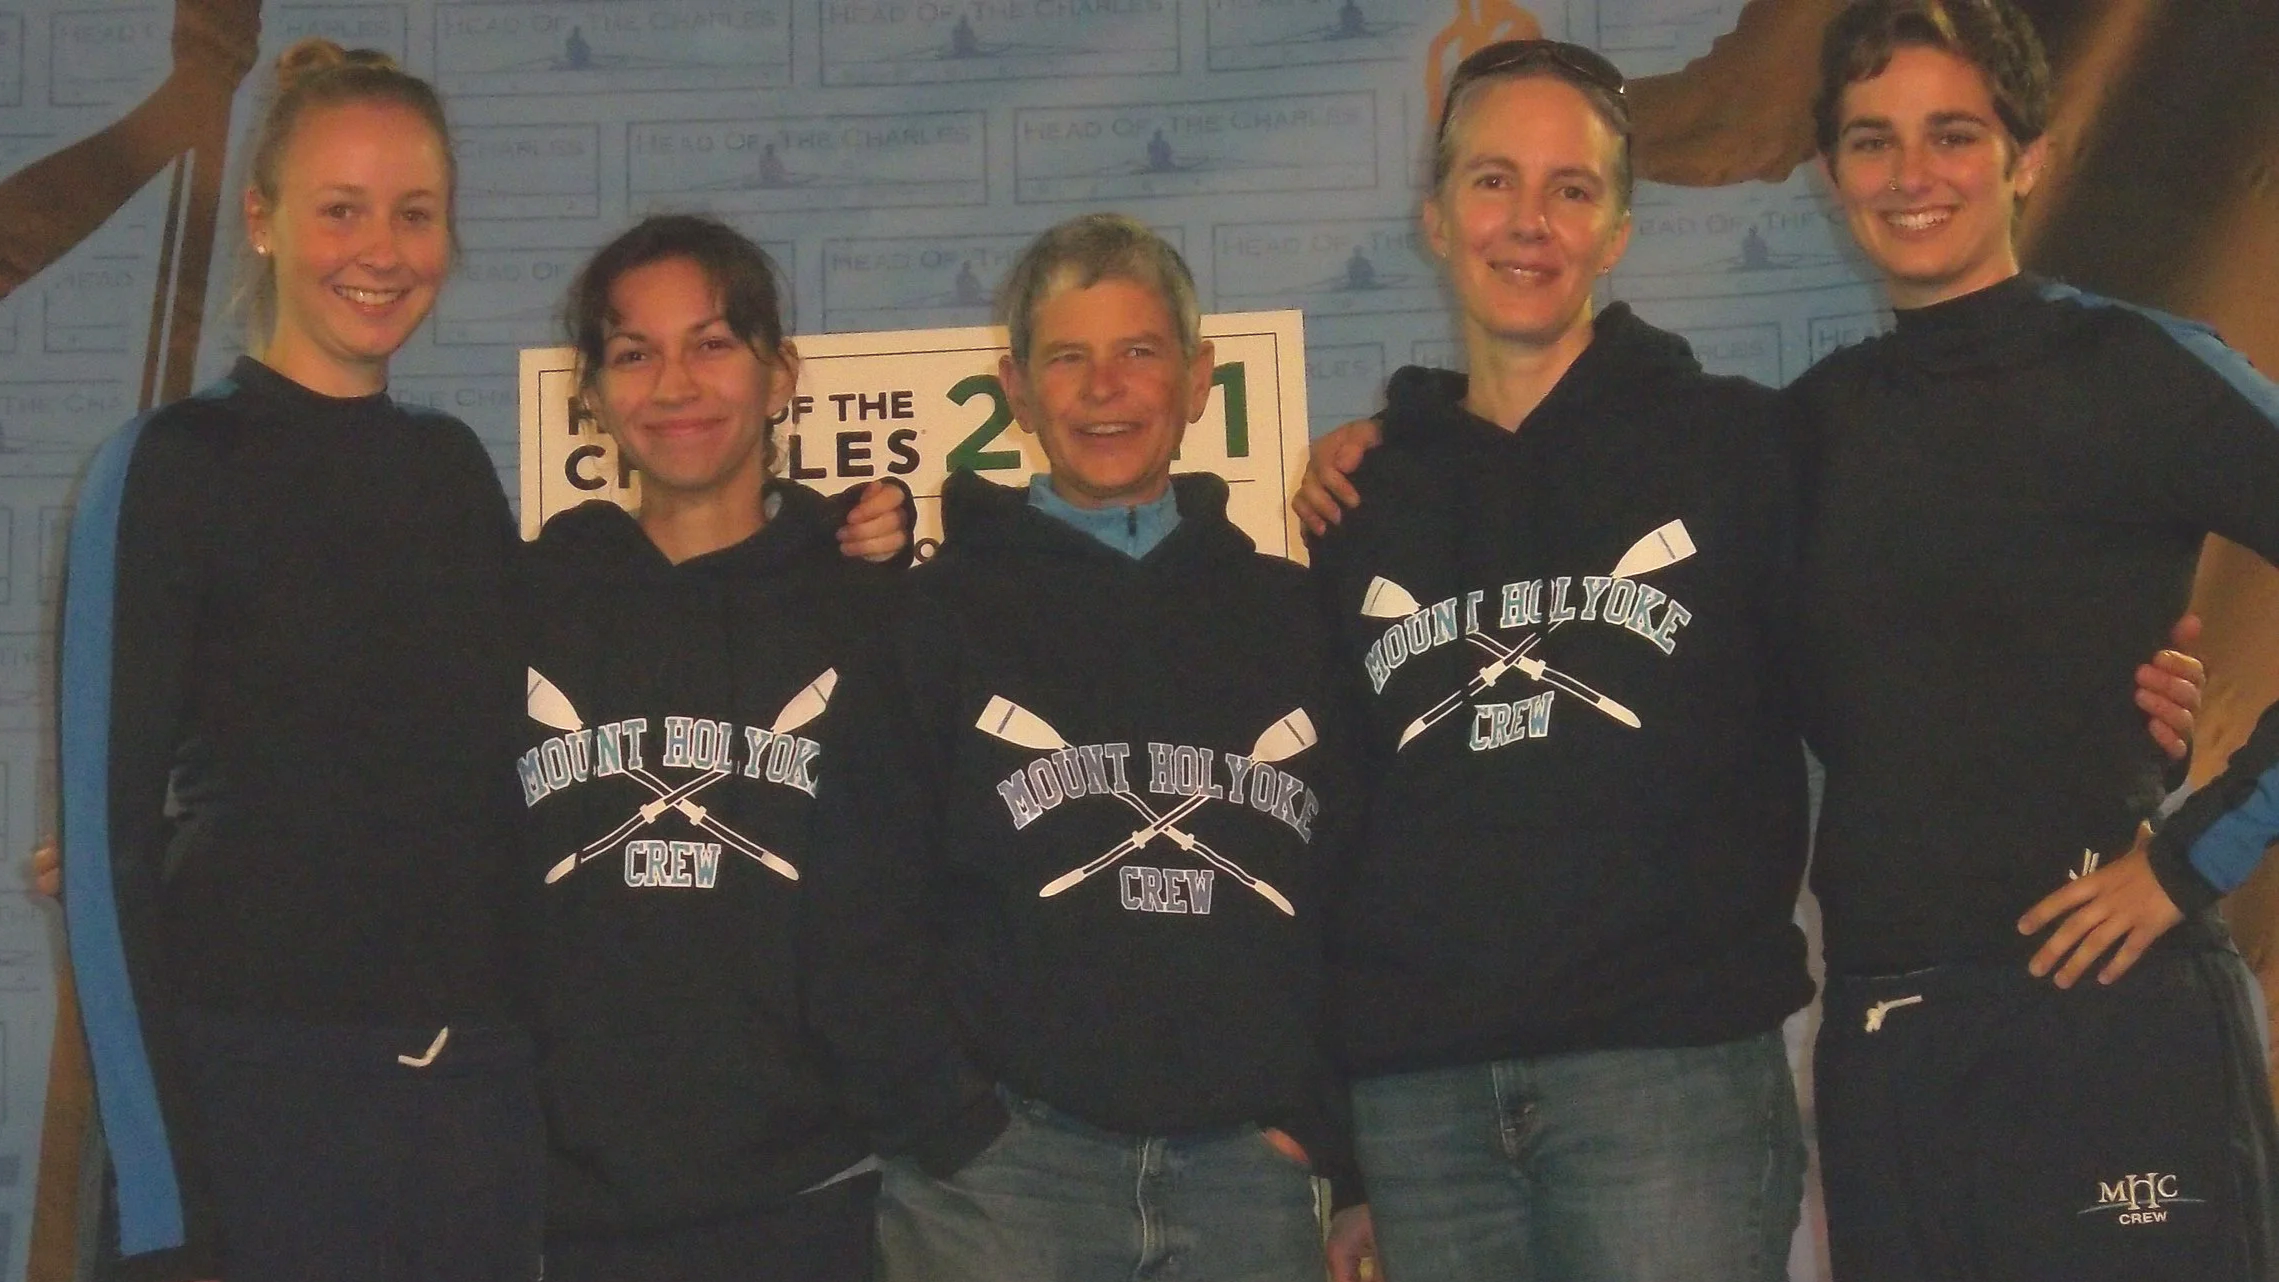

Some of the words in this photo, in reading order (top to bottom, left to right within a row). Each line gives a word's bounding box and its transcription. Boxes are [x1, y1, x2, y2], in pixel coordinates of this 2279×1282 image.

[829, 390, 914, 422] THE
[1363, 589, 1485, 695] MOUNT
[1468, 690, 1555, 752] CREW
[516, 717, 648, 809] MOUNT
[995, 742, 1131, 831] MOUNT
[1148, 741, 1321, 844] HOLYOKE
[623, 839, 722, 889] CREW
[1119, 865, 1215, 915] CREW
[2098, 1172, 2179, 1211] MHC
[2118, 1211, 2168, 1226] CREW
